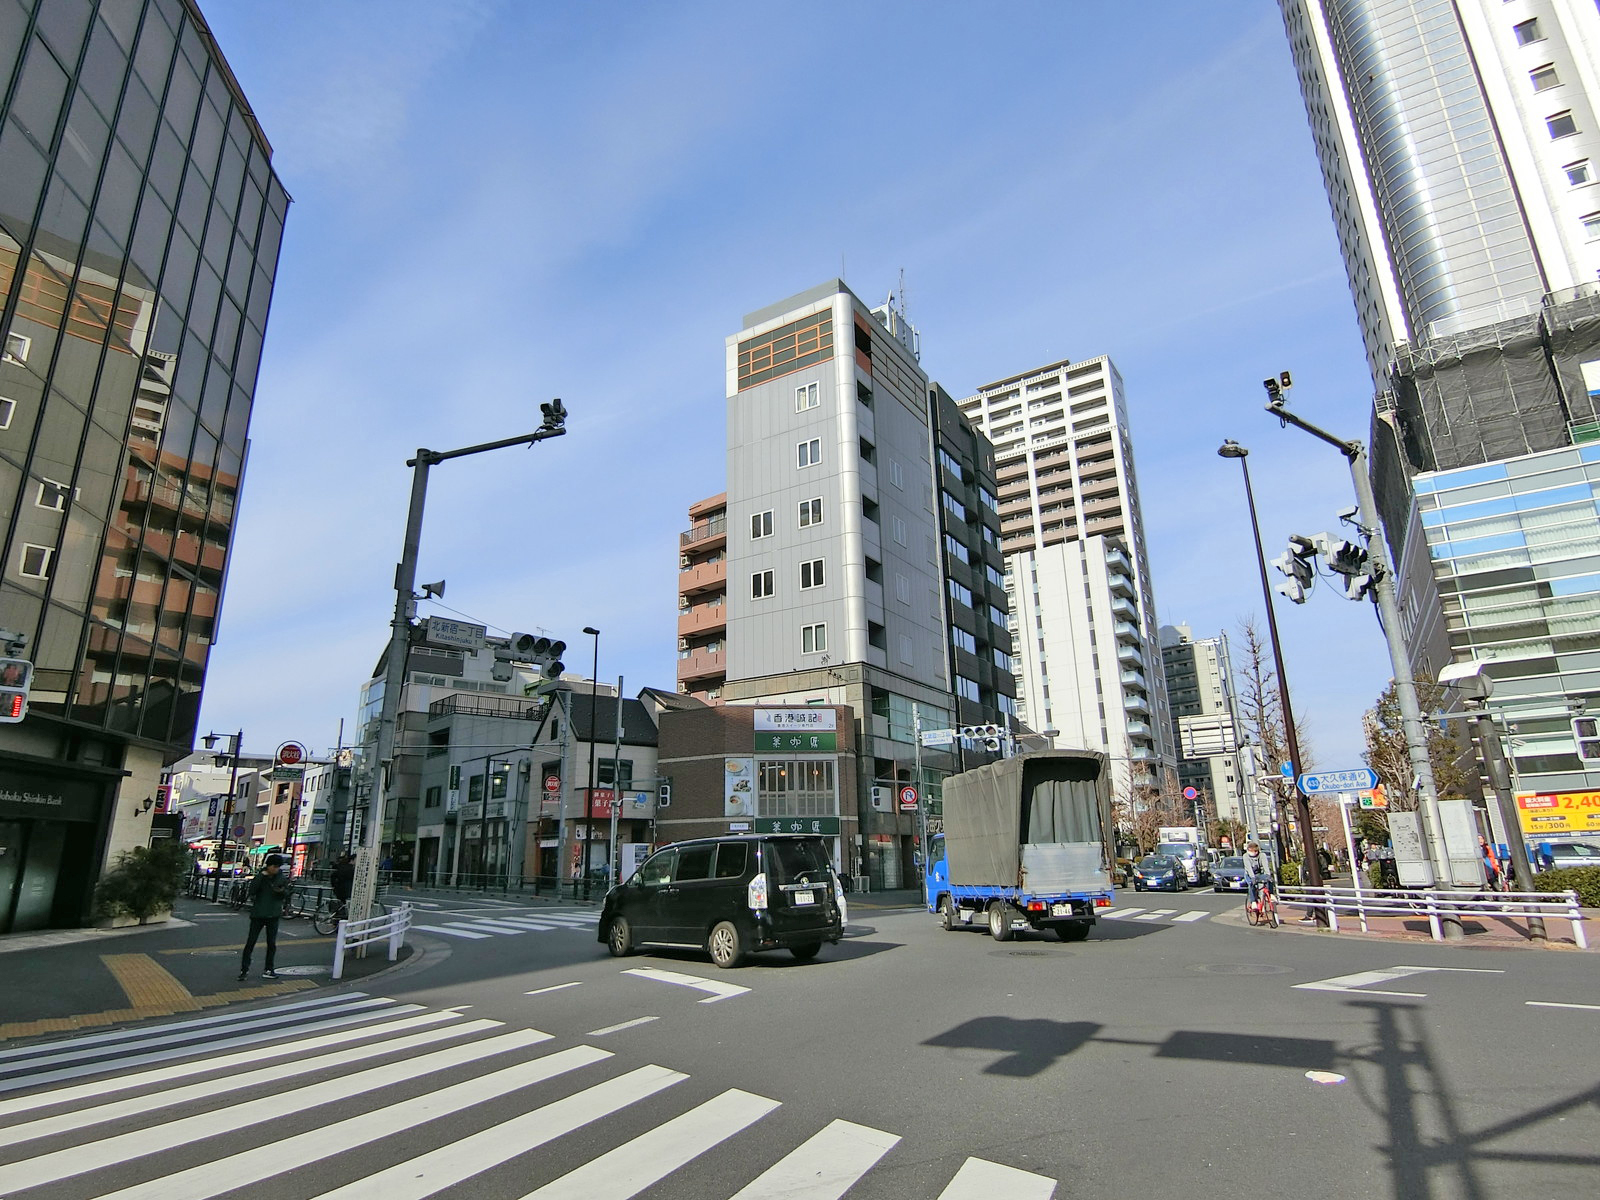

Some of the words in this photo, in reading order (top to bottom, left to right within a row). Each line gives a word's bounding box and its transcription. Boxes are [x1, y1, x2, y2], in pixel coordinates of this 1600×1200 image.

[431, 620, 484, 639] 北新宿一丁目
[435, 632, 472, 644] Kitashinjuku
[1320, 772, 1366, 783] 大久保通り
[1307, 780, 1319, 788] 433
